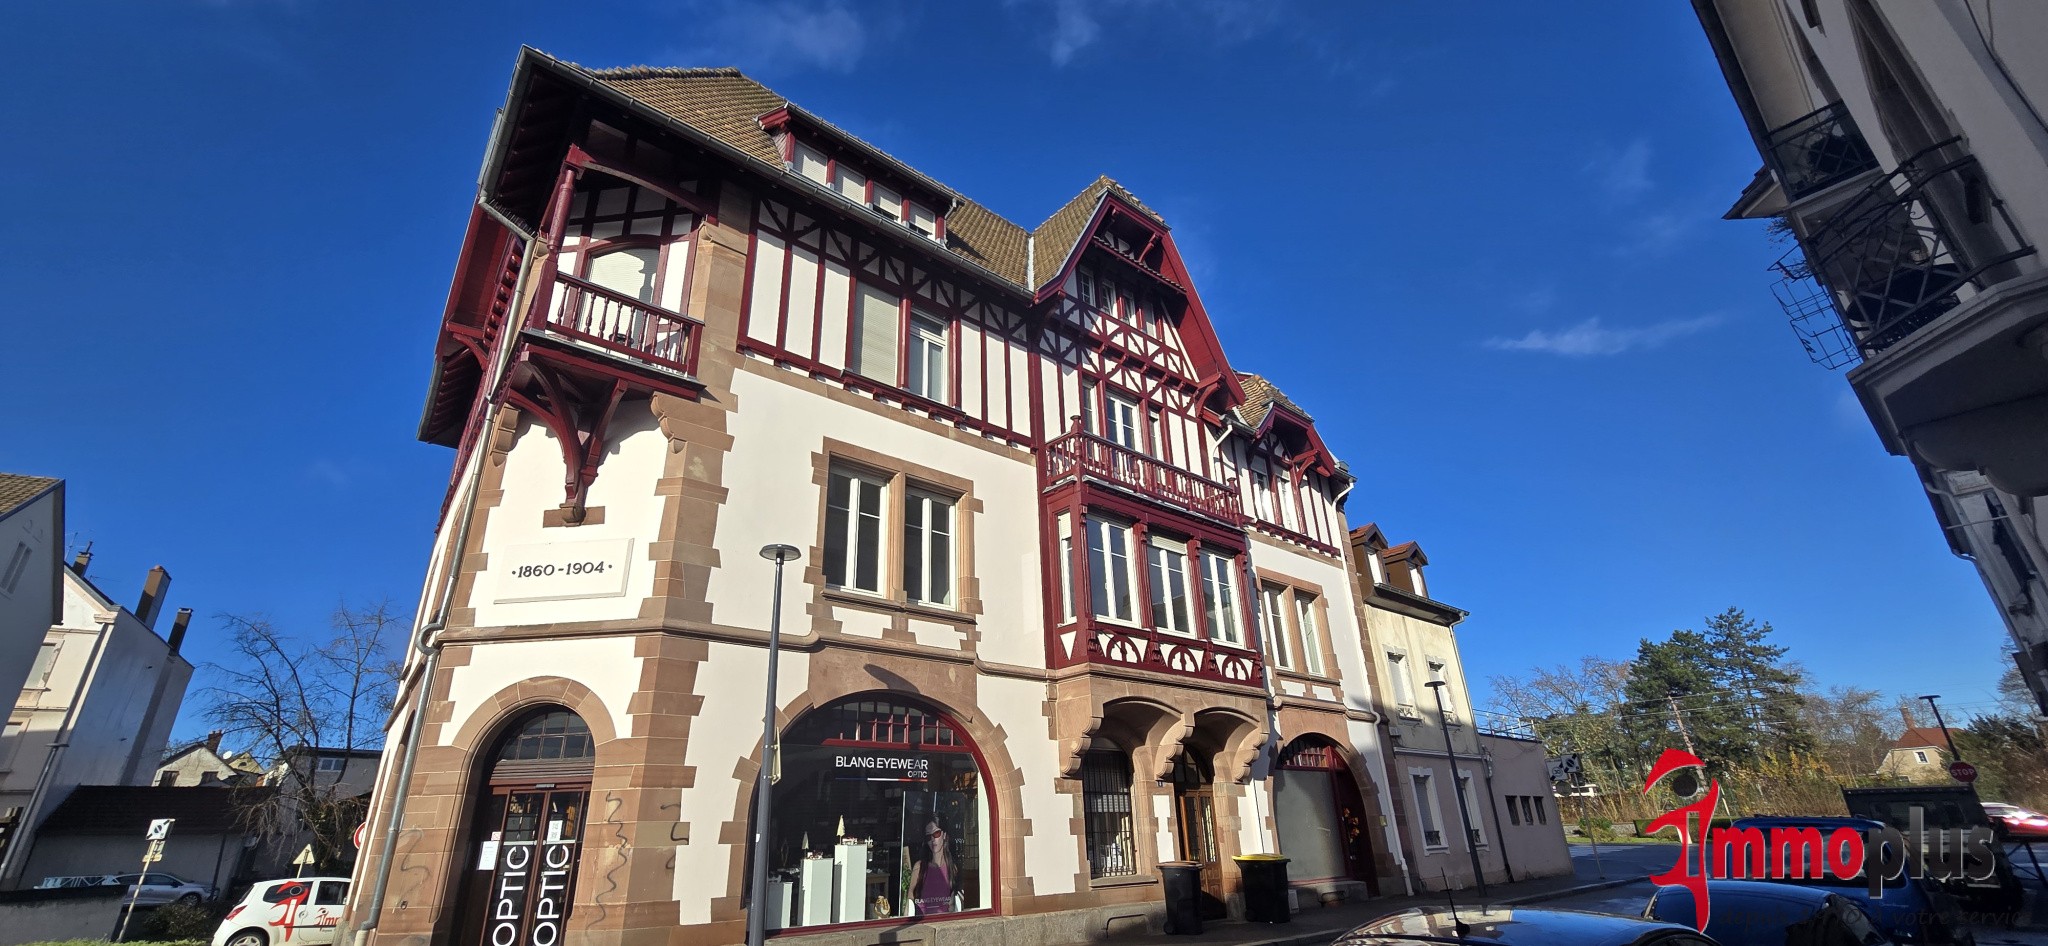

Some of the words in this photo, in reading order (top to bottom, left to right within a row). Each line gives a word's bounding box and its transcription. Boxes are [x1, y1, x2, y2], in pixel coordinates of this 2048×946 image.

[835, 755, 875, 768] BLANG
[876, 757, 929, 770] EYEWEAR
[907, 770, 928, 778] OPTIC
[1952, 768, 1975, 777] STOP
[492, 845, 529, 946] OPTIC
[533, 844, 569, 946] OPTIC
